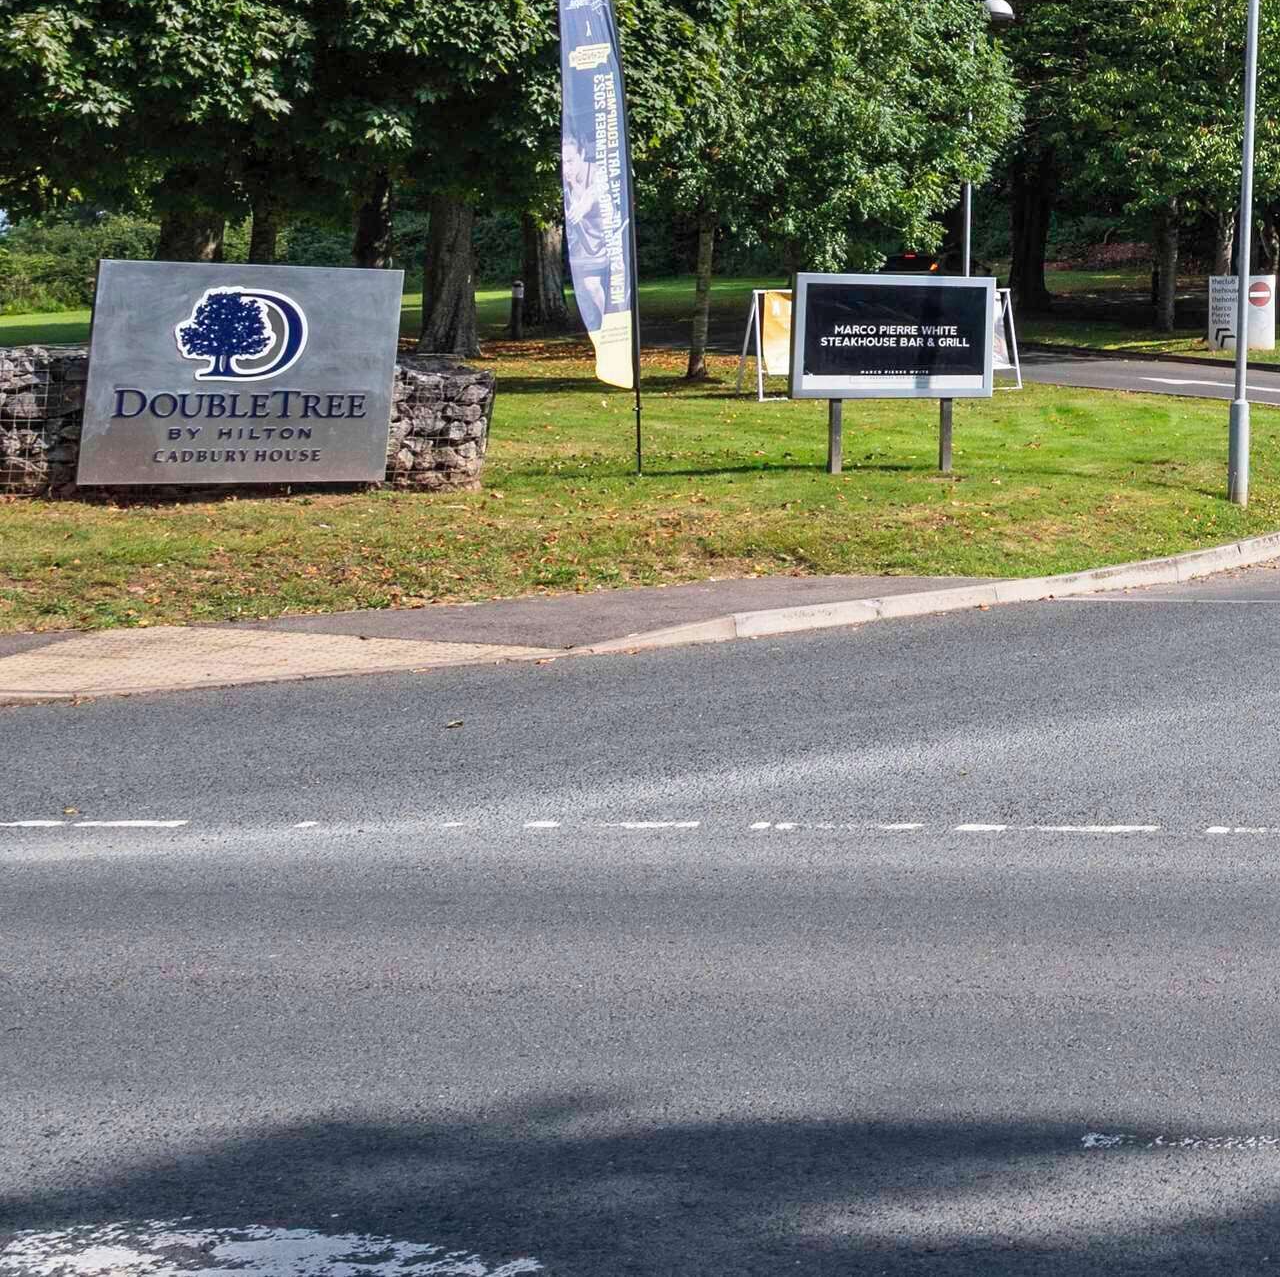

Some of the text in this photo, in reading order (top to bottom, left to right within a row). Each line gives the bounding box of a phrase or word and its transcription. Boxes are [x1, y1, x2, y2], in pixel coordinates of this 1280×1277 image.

[834, 325, 958, 336] MARCO PIERRE WHITE
[820, 336, 970, 347] STEAKHOUSE BAR & GRILL
[168, 427, 313, 440] BY HILTON
[152, 449, 321, 463] CADBURY HOUSE
